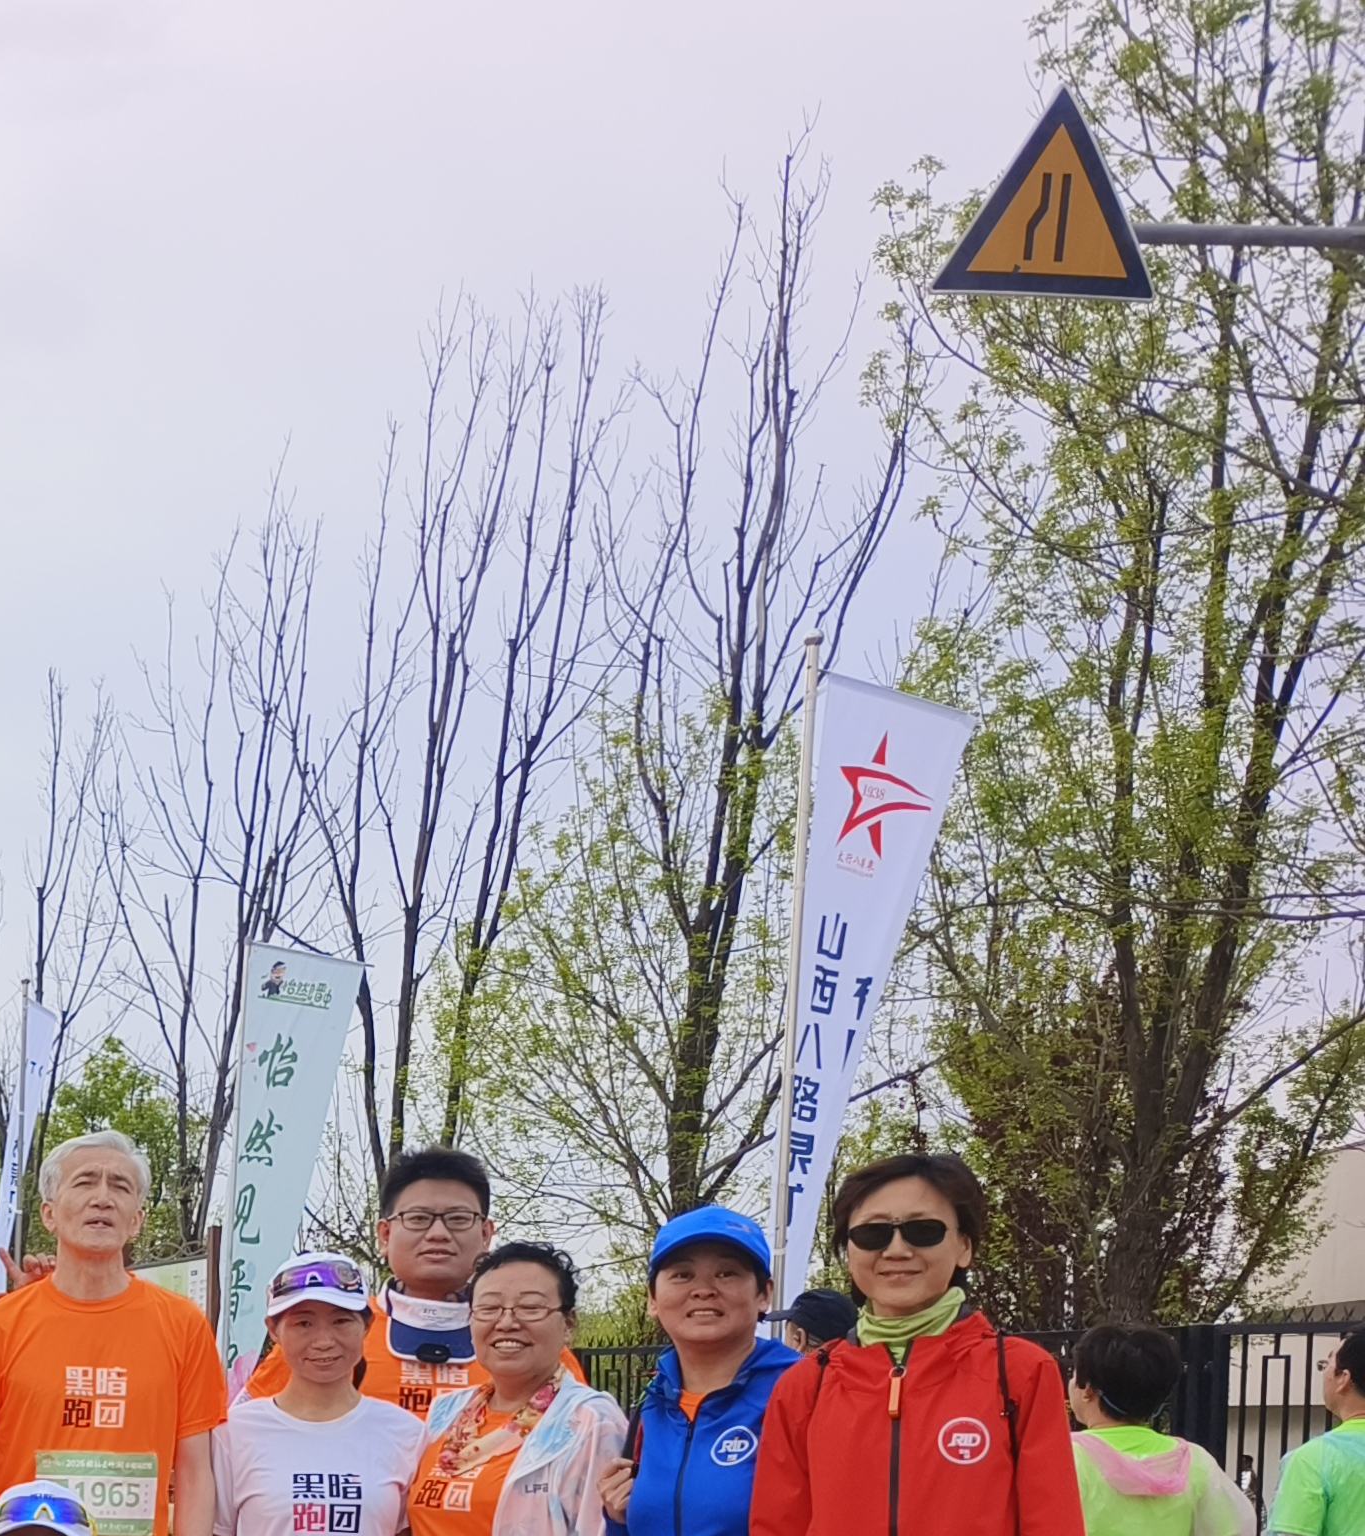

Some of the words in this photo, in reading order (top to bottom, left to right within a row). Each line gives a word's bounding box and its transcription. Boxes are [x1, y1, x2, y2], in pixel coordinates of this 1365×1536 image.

[862, 783, 886, 800] 1938
[65, 1366, 128, 1397] 黑暗
[399, 1361, 470, 1386] 黑暗
[61, 1398, 126, 1428] 跑团
[719, 1435, 750, 1454] RID
[948, 1432, 982, 1448] RID
[74, 1481, 141, 1508] 1965
[292, 1472, 363, 1501] 黑暗
[414, 1478, 473, 1512] 跑团
[292, 1503, 362, 1535] 跑团
